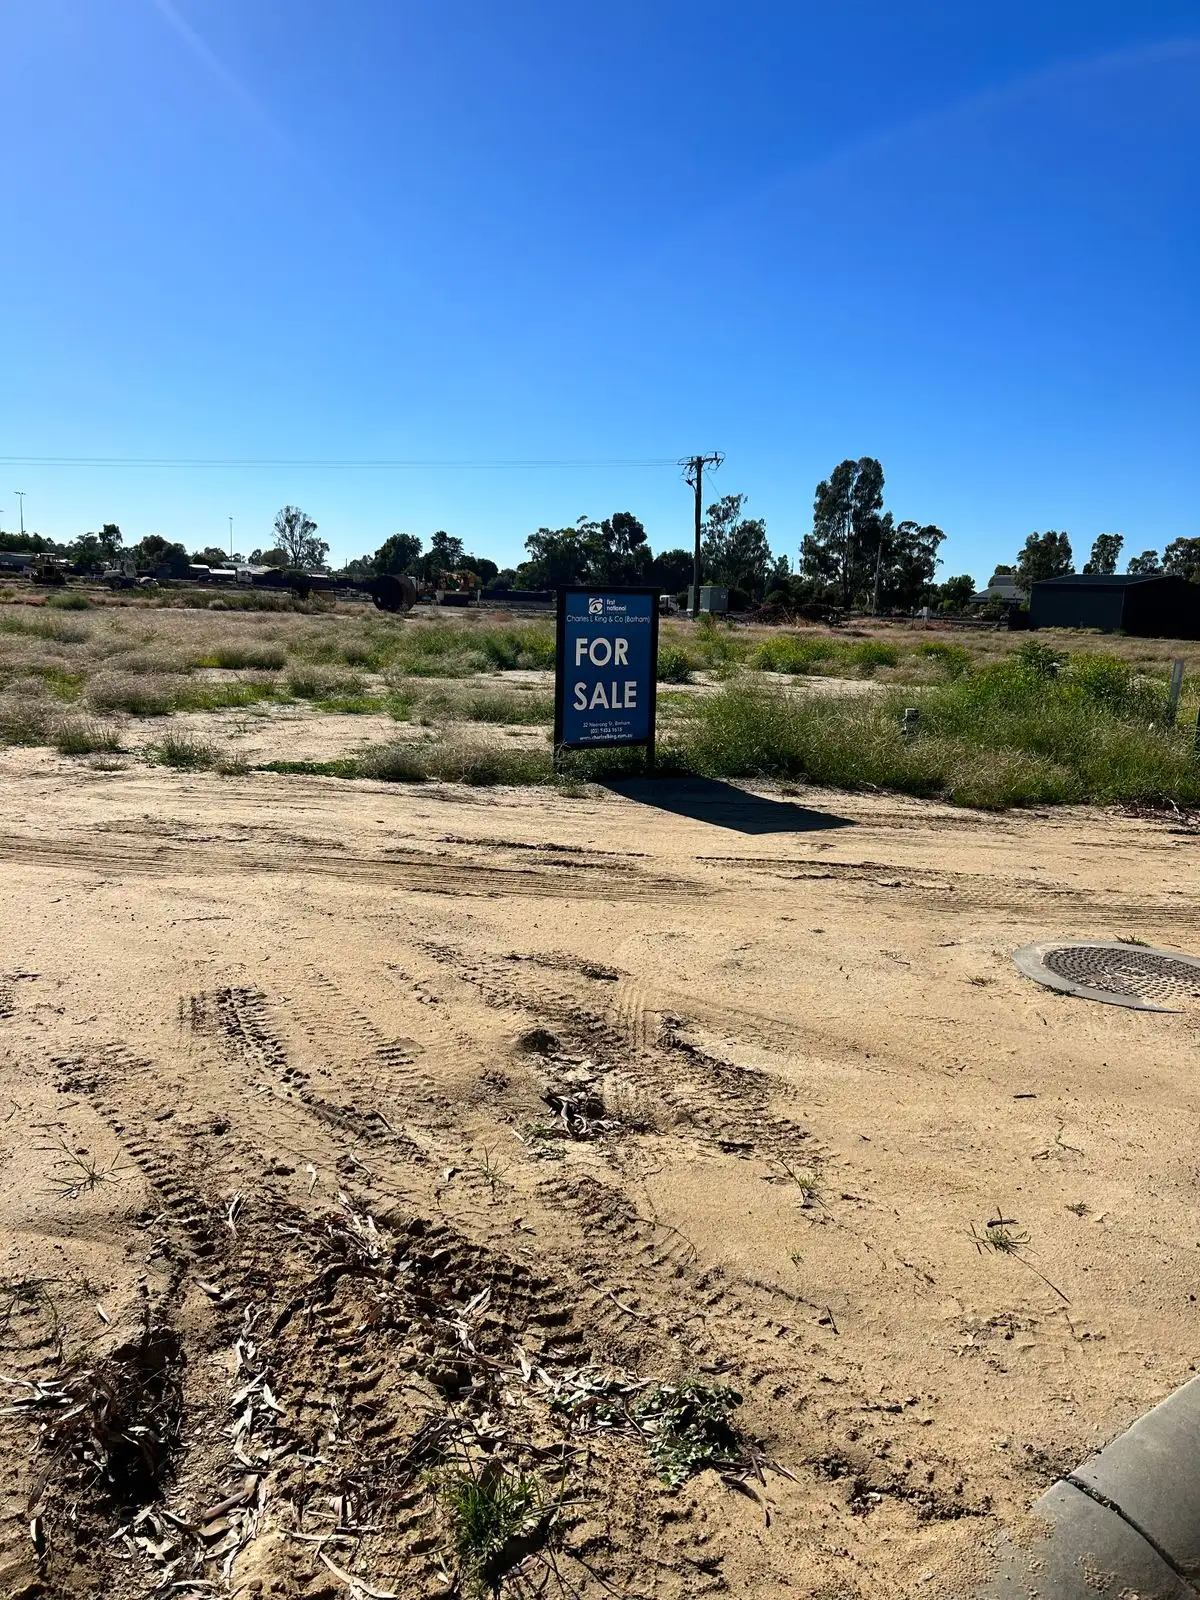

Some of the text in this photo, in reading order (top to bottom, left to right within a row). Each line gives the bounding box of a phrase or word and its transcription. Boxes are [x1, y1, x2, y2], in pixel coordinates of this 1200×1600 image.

[566, 615, 589, 623] Charles
[594, 616, 607, 624] King
[624, 616, 651, 624] (Barham)
[575, 637, 629, 666] FOR
[573, 681, 637, 711] SALE
